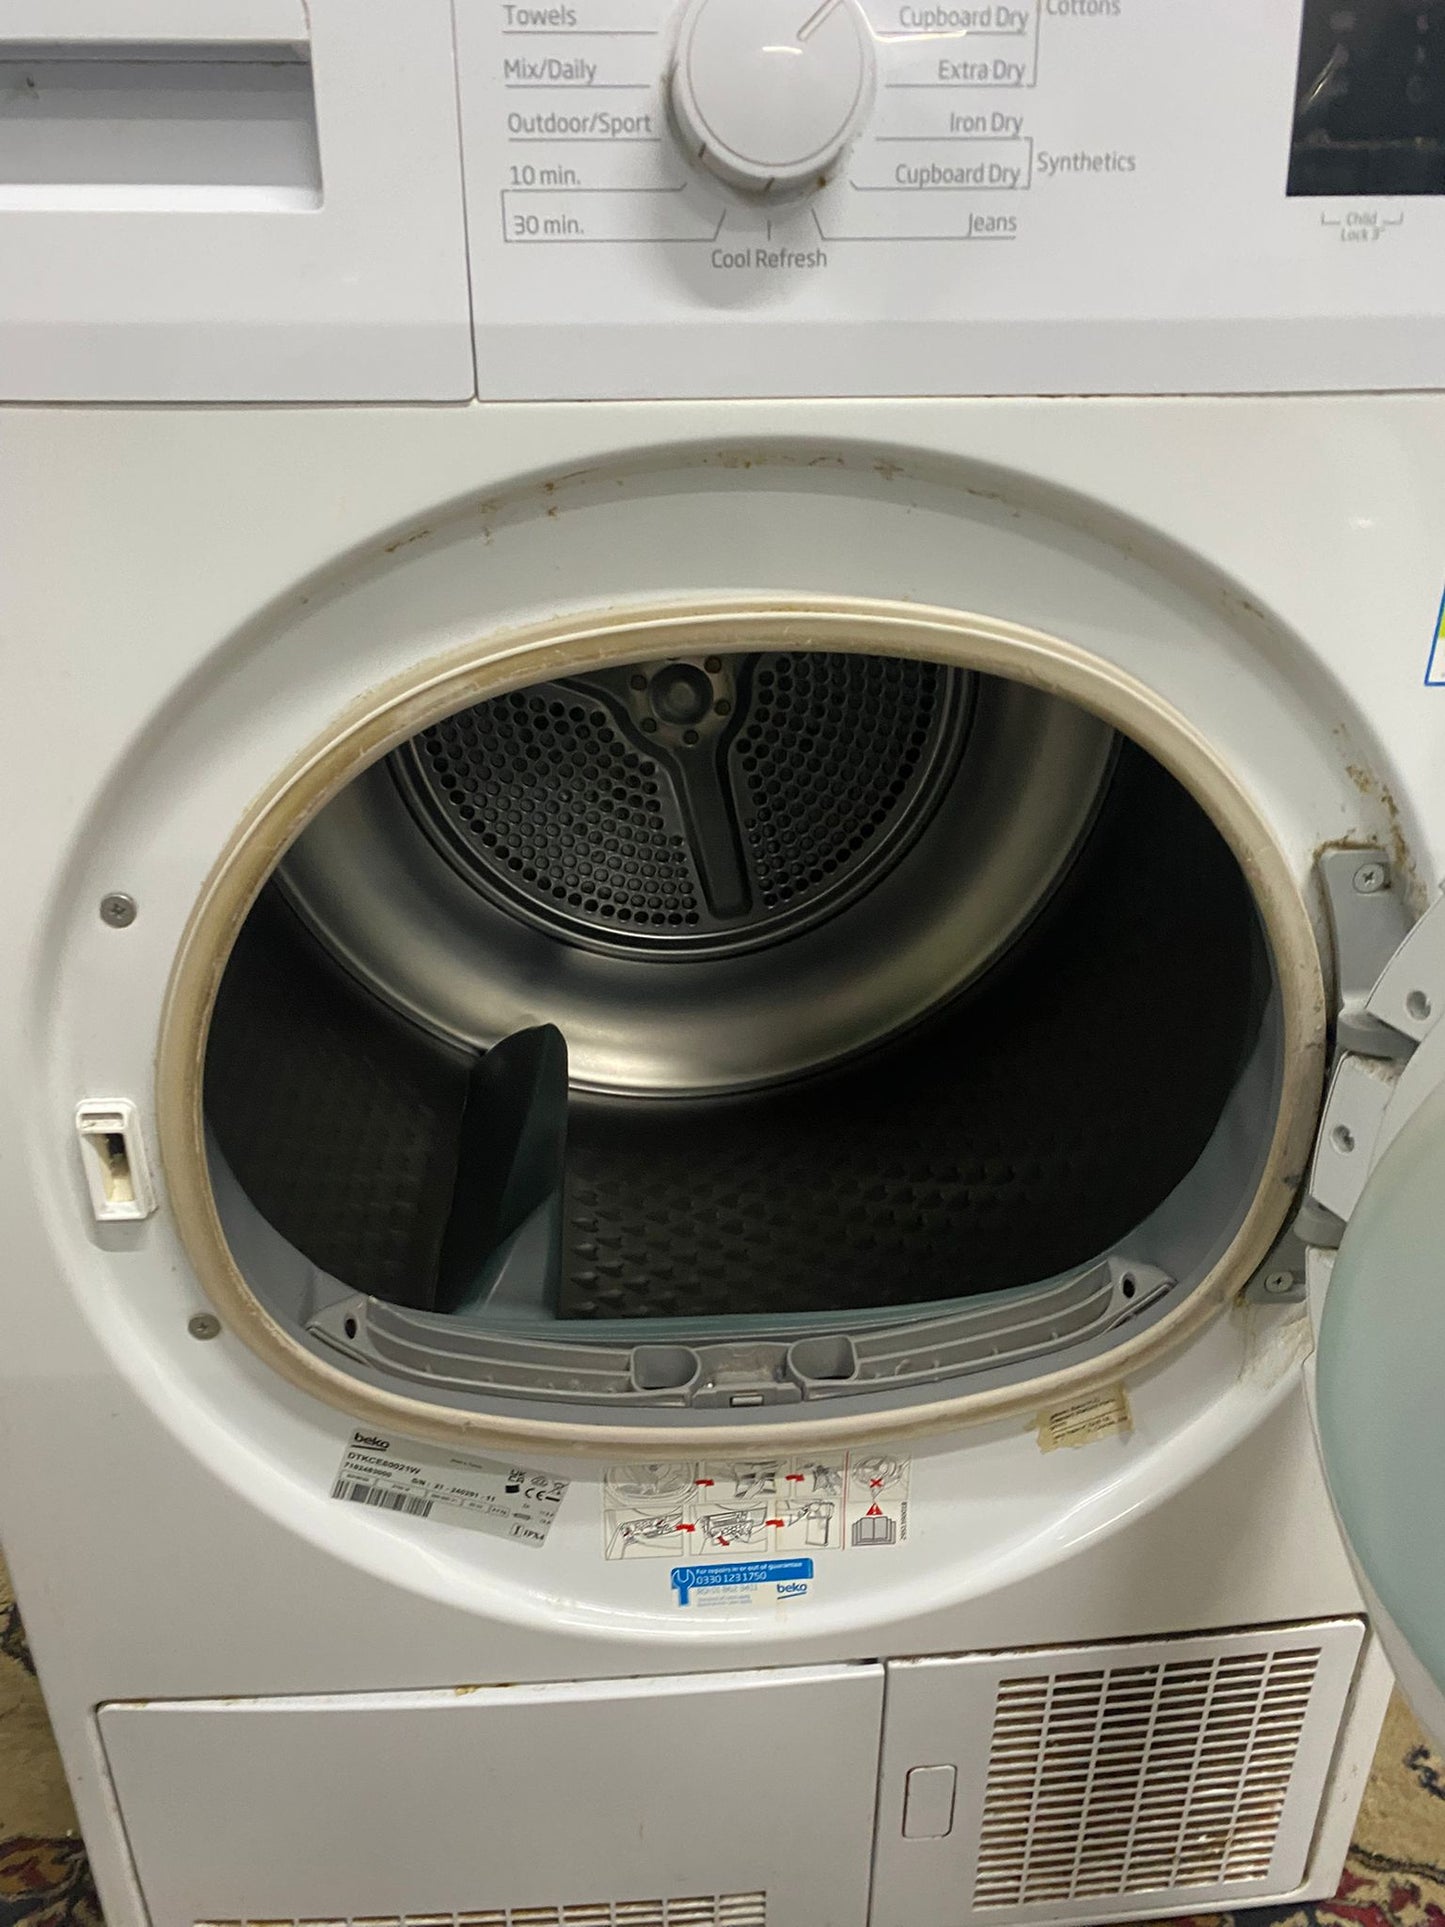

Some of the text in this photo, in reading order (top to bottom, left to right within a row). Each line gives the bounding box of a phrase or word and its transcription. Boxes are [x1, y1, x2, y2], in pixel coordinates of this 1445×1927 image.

[505, 4, 577, 26] Towels
[900, 5, 1029, 30] Cupboard Dry
[504, 59, 597, 83] Mix/Daily
[938, 60, 1026, 84] Extra Dry
[508, 113, 652, 138] Outdoor/Sport
[950, 113, 1023, 136] Iron Dry
[1037, 151, 1137, 173] Synthetics
[510, 166, 581, 185] 10 min.
[895, 163, 1021, 188] Cupboard Dry
[513, 215, 585, 235] 30 min.
[968, 213, 1017, 236] Jeans
[711, 249, 828, 268] Cool Refresh
[354, 1432, 390, 1449] beko
[696, 1575, 721, 1586] 0330
[743, 1571, 767, 1582] 1750
[777, 1582, 808, 1593] beko
